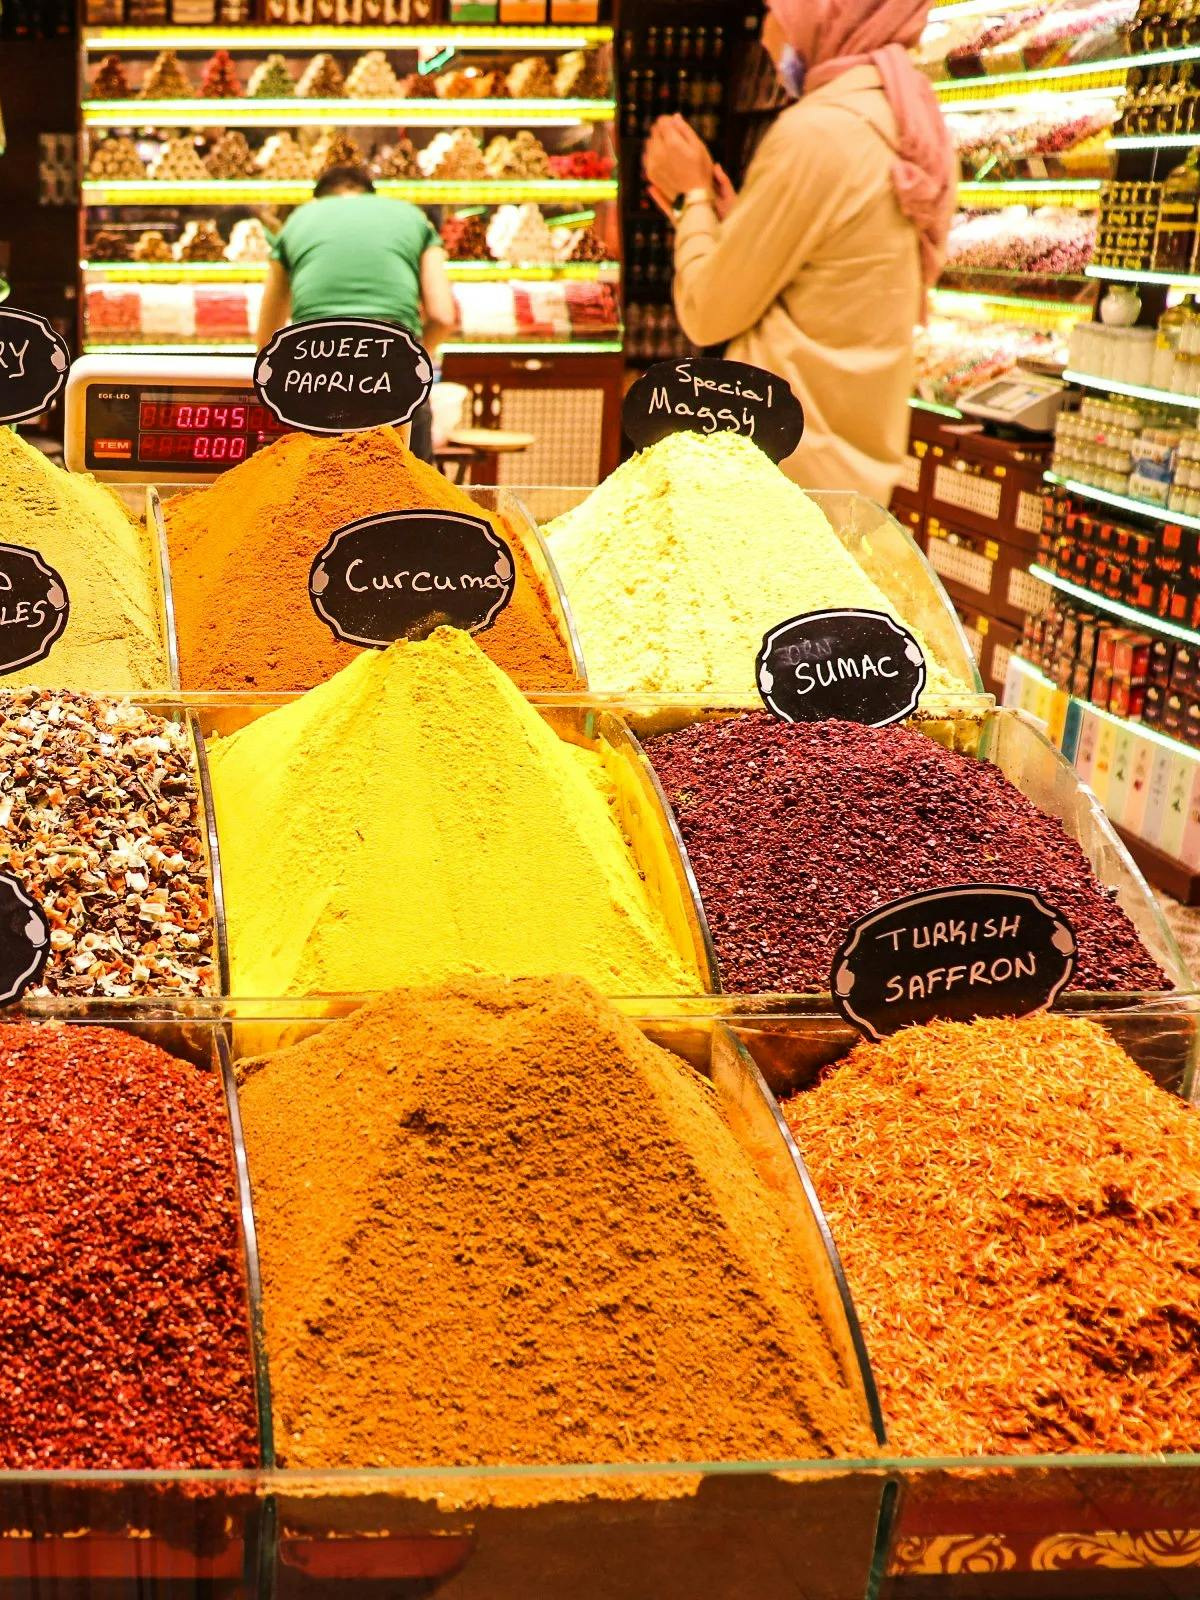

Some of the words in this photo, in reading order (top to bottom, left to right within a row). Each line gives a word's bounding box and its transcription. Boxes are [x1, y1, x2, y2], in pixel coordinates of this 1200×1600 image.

[293, 338, 394, 360] SWEET
[284, 369, 392, 394] PAPRICA
[675, 363, 773, 408] Special
[176, 406, 245, 429] 0.045
[648, 386, 755, 437] Maggy
[99, 441, 130, 449] TEM
[193, 437, 245, 459] 0.00
[345, 558, 509, 592] Curcuma
[795, 654, 899, 694] SUMAC
[875, 915, 1021, 951] TURKISH
[885, 951, 1038, 1002] SAFFRON
